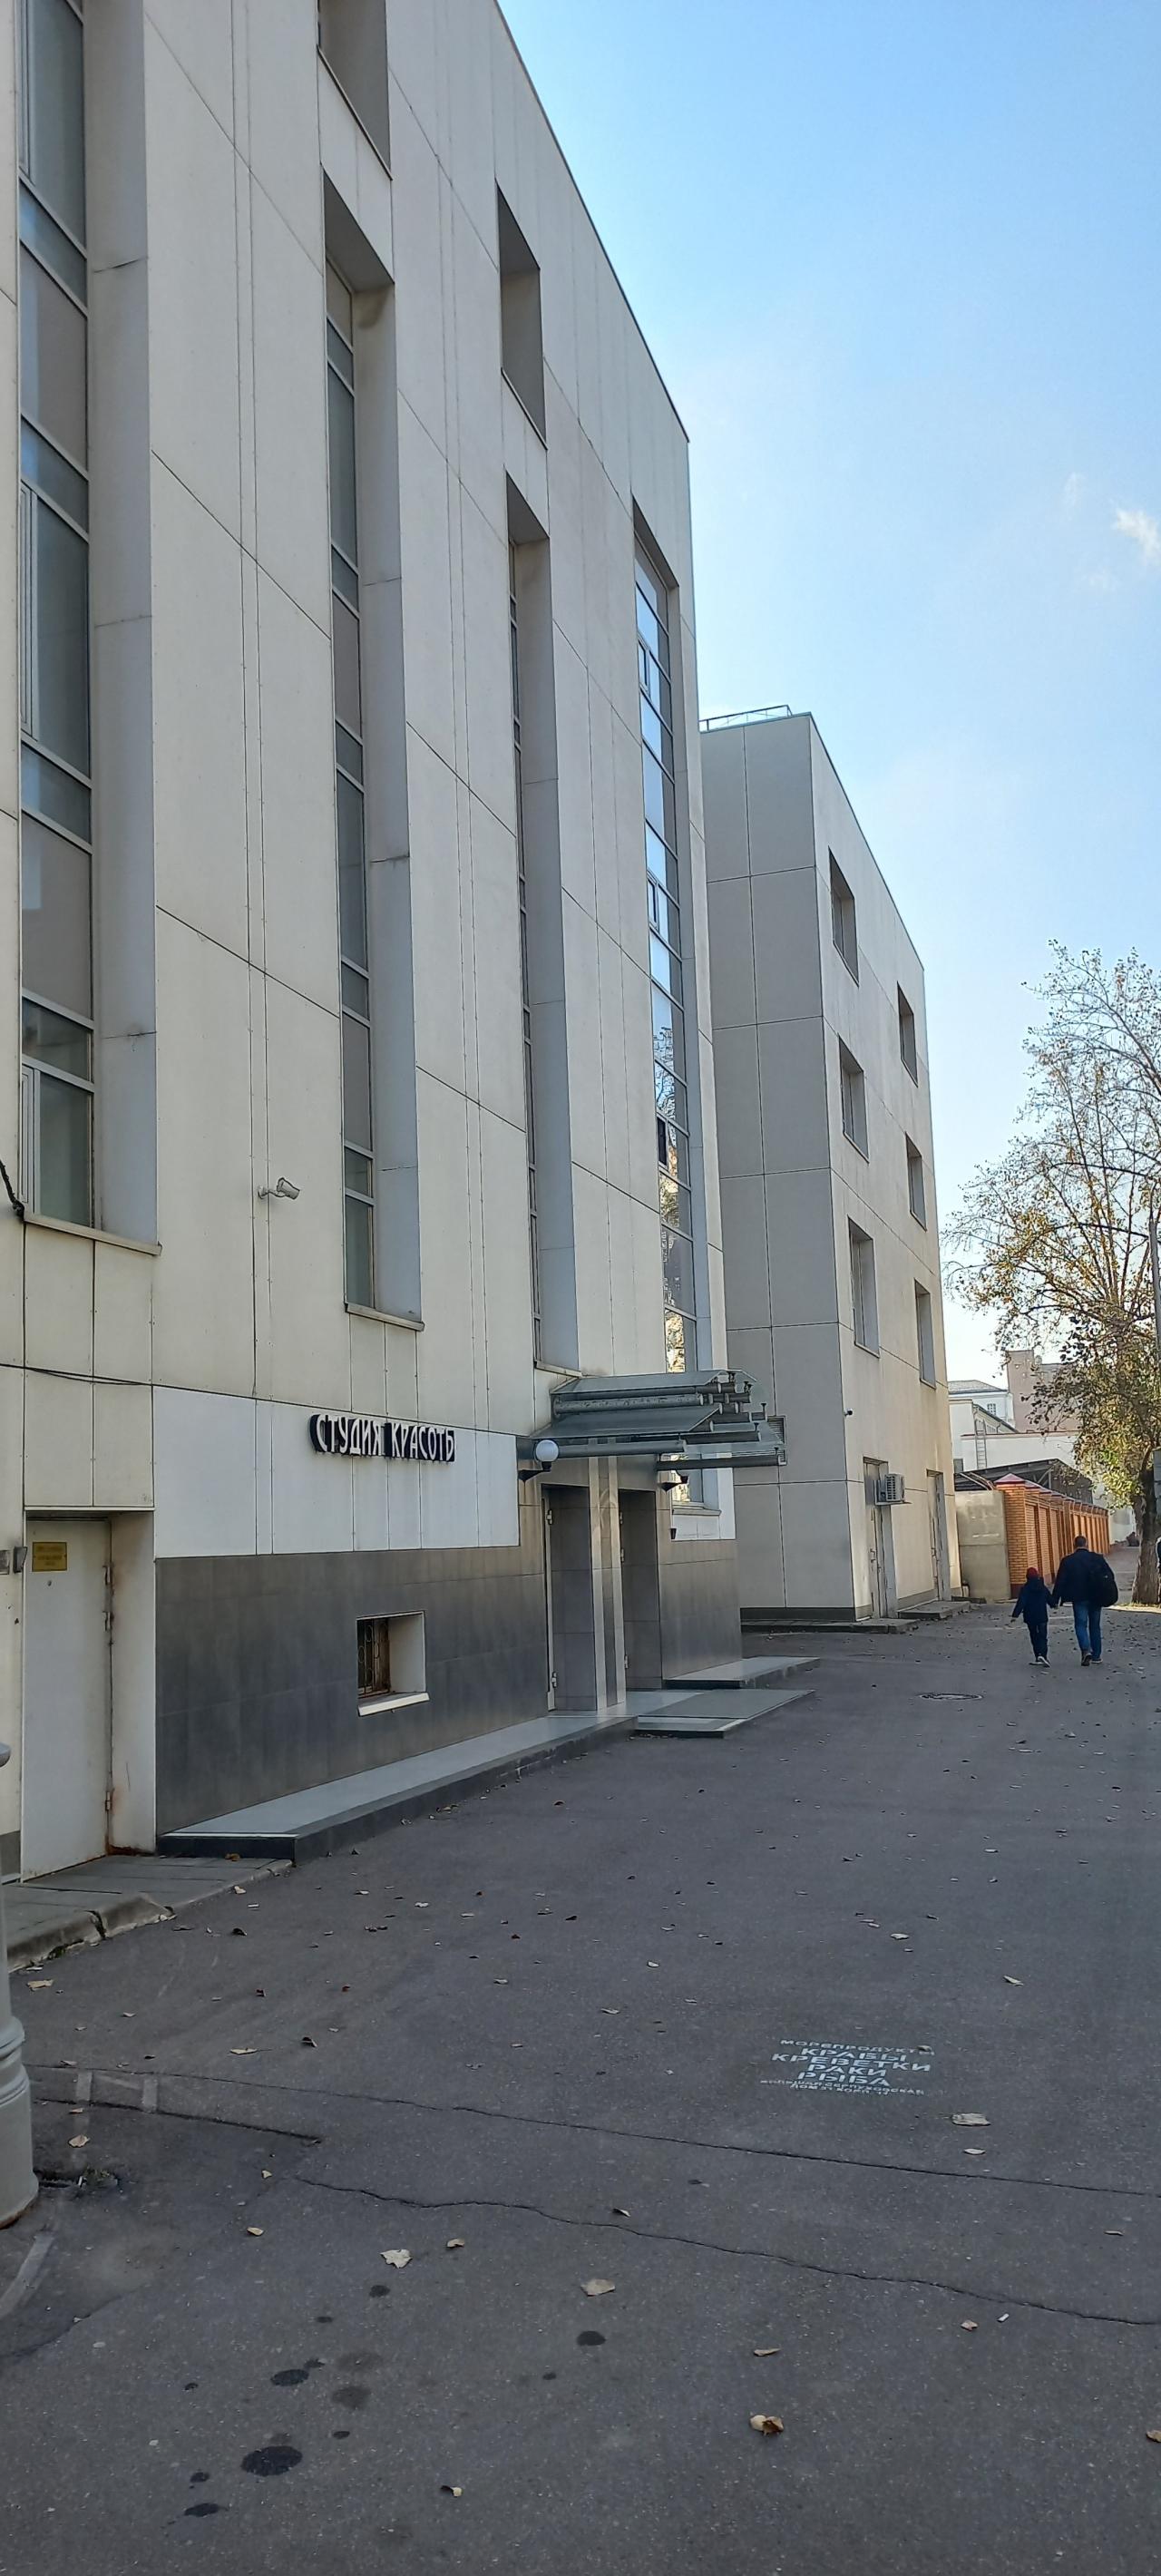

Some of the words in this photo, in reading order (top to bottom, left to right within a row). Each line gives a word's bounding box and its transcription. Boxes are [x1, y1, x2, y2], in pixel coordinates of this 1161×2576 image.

[310, 1414, 383, 1456] СТУДИЯ
[801, 2048, 907, 2062] КРАБЫ
[771, 2054, 932, 2072] КРЕВЕТКИ
[807, 2064, 887, 2077] РАКИ
[797, 2072, 891, 2087] РЫБА
